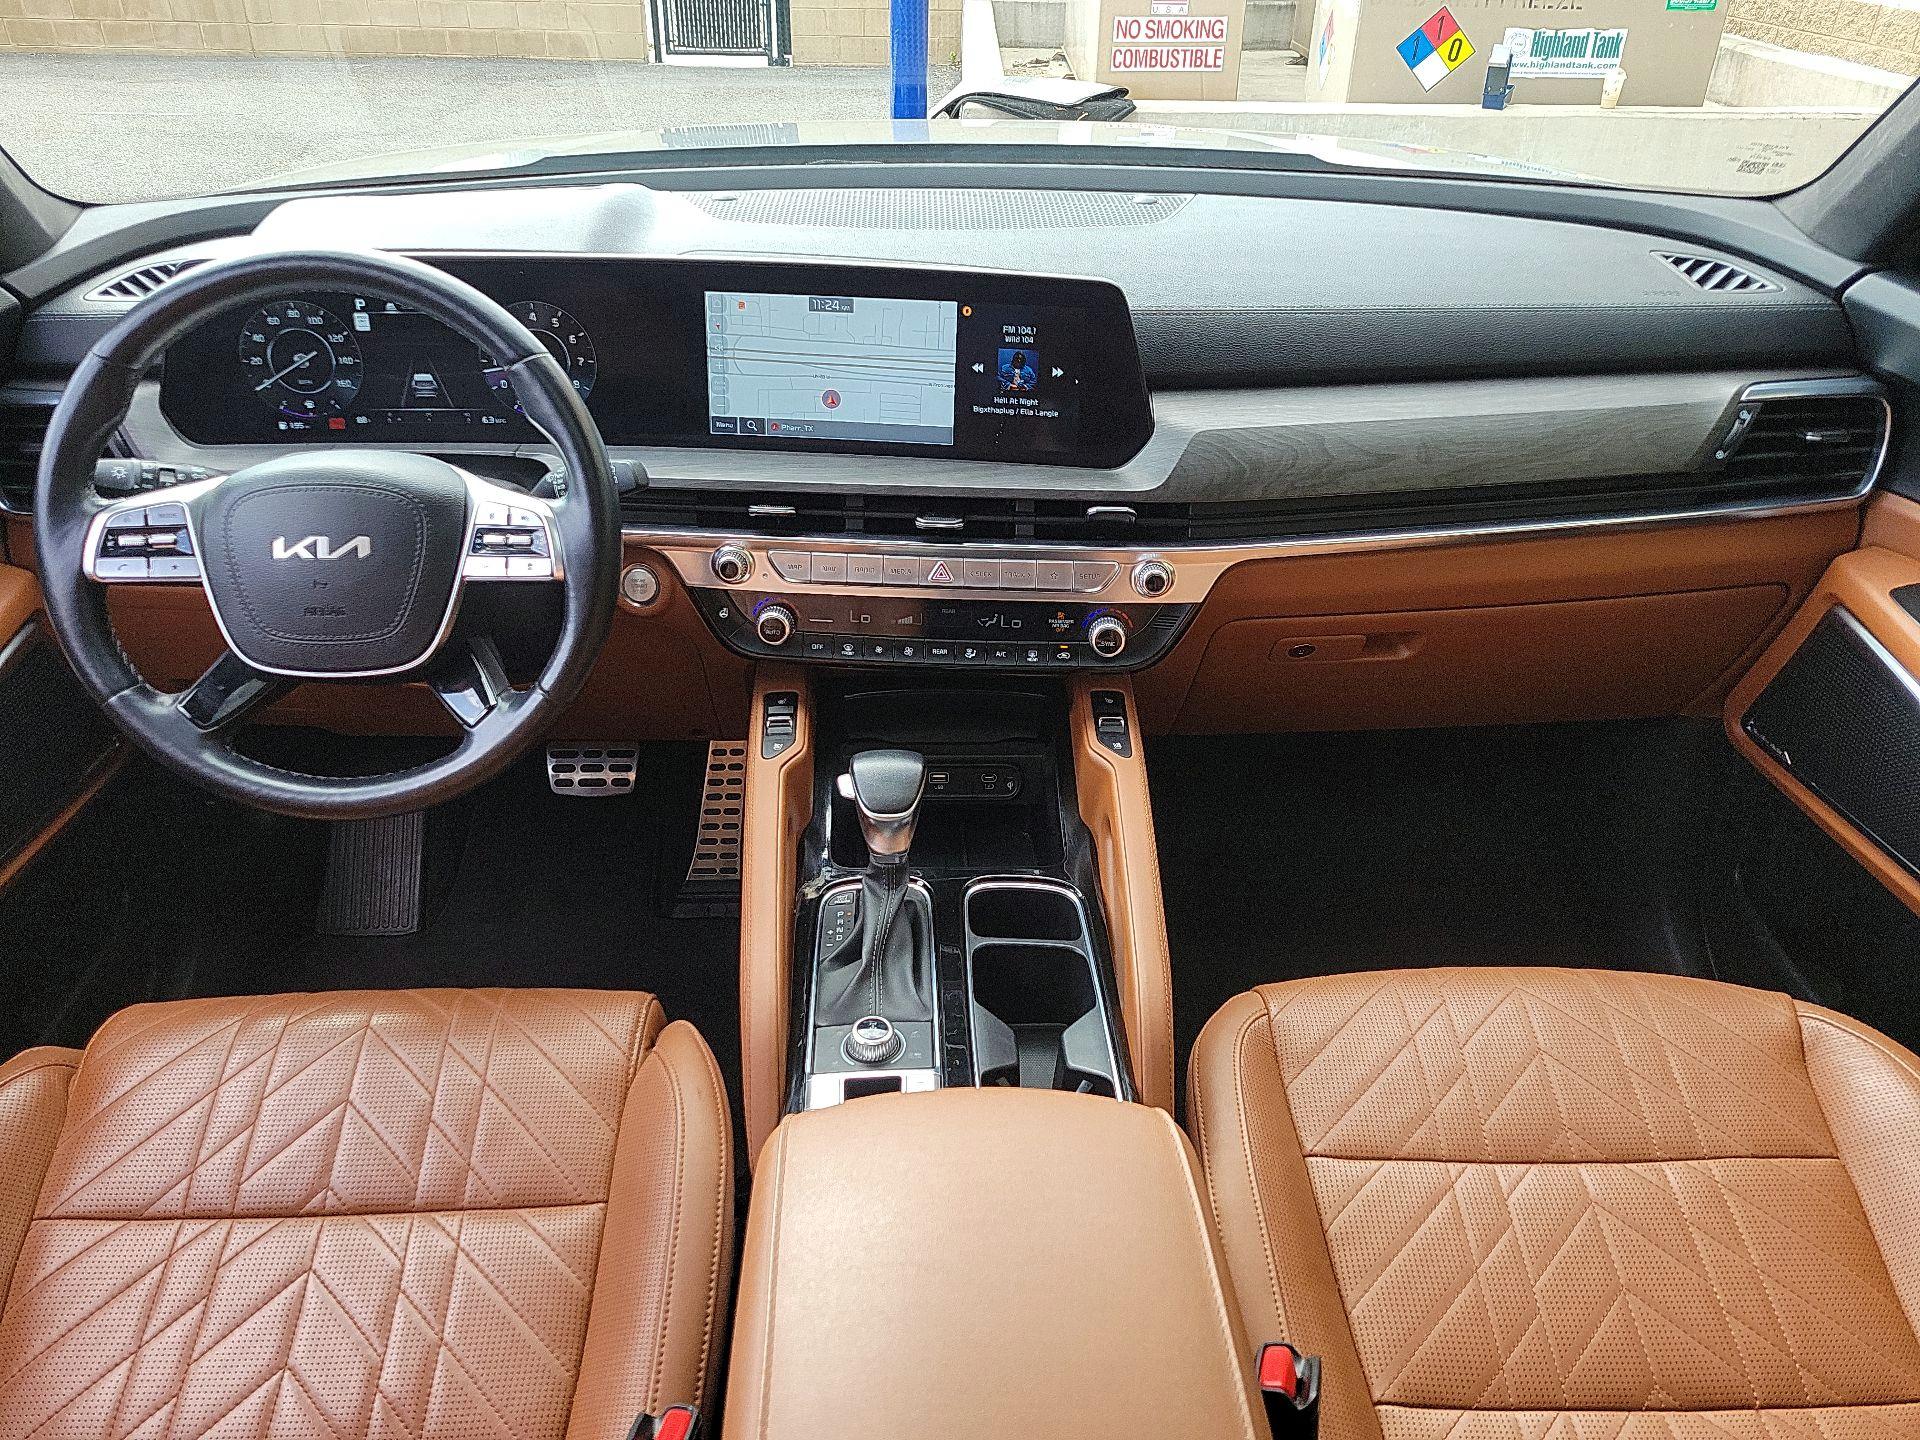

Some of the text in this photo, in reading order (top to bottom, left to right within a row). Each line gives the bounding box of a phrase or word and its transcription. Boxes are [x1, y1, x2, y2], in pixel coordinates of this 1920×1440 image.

[1115, 19, 1224, 40] NO SMOKING
[1436, 15, 1446, 41] 1
[1447, 37, 1463, 63] 0
[1530, 31, 1590, 61] Highland
[1591, 31, 1624, 59] Tank
[1112, 48, 1223, 69] COMBUSTIBLE
[1510, 61, 1617, 71] ww.highlandtank.com
[354, 298, 366, 311] P
[812, 299, 840, 311] 11:24
[551, 318, 560, 328] 5
[1002, 325, 1016, 334] FM
[328, 334, 344, 343] 120
[568, 334, 577, 344] 6
[1021, 335, 1034, 344] 104
[250, 357, 263, 365] 20
[993, 396, 1008, 404] Hell
[1019, 398, 1039, 407] Night
[1020, 408, 1034, 416] Ella
[804, 424, 814, 432] TX
[272, 535, 371, 560] KIA
[995, 650, 1007, 658] A/C
